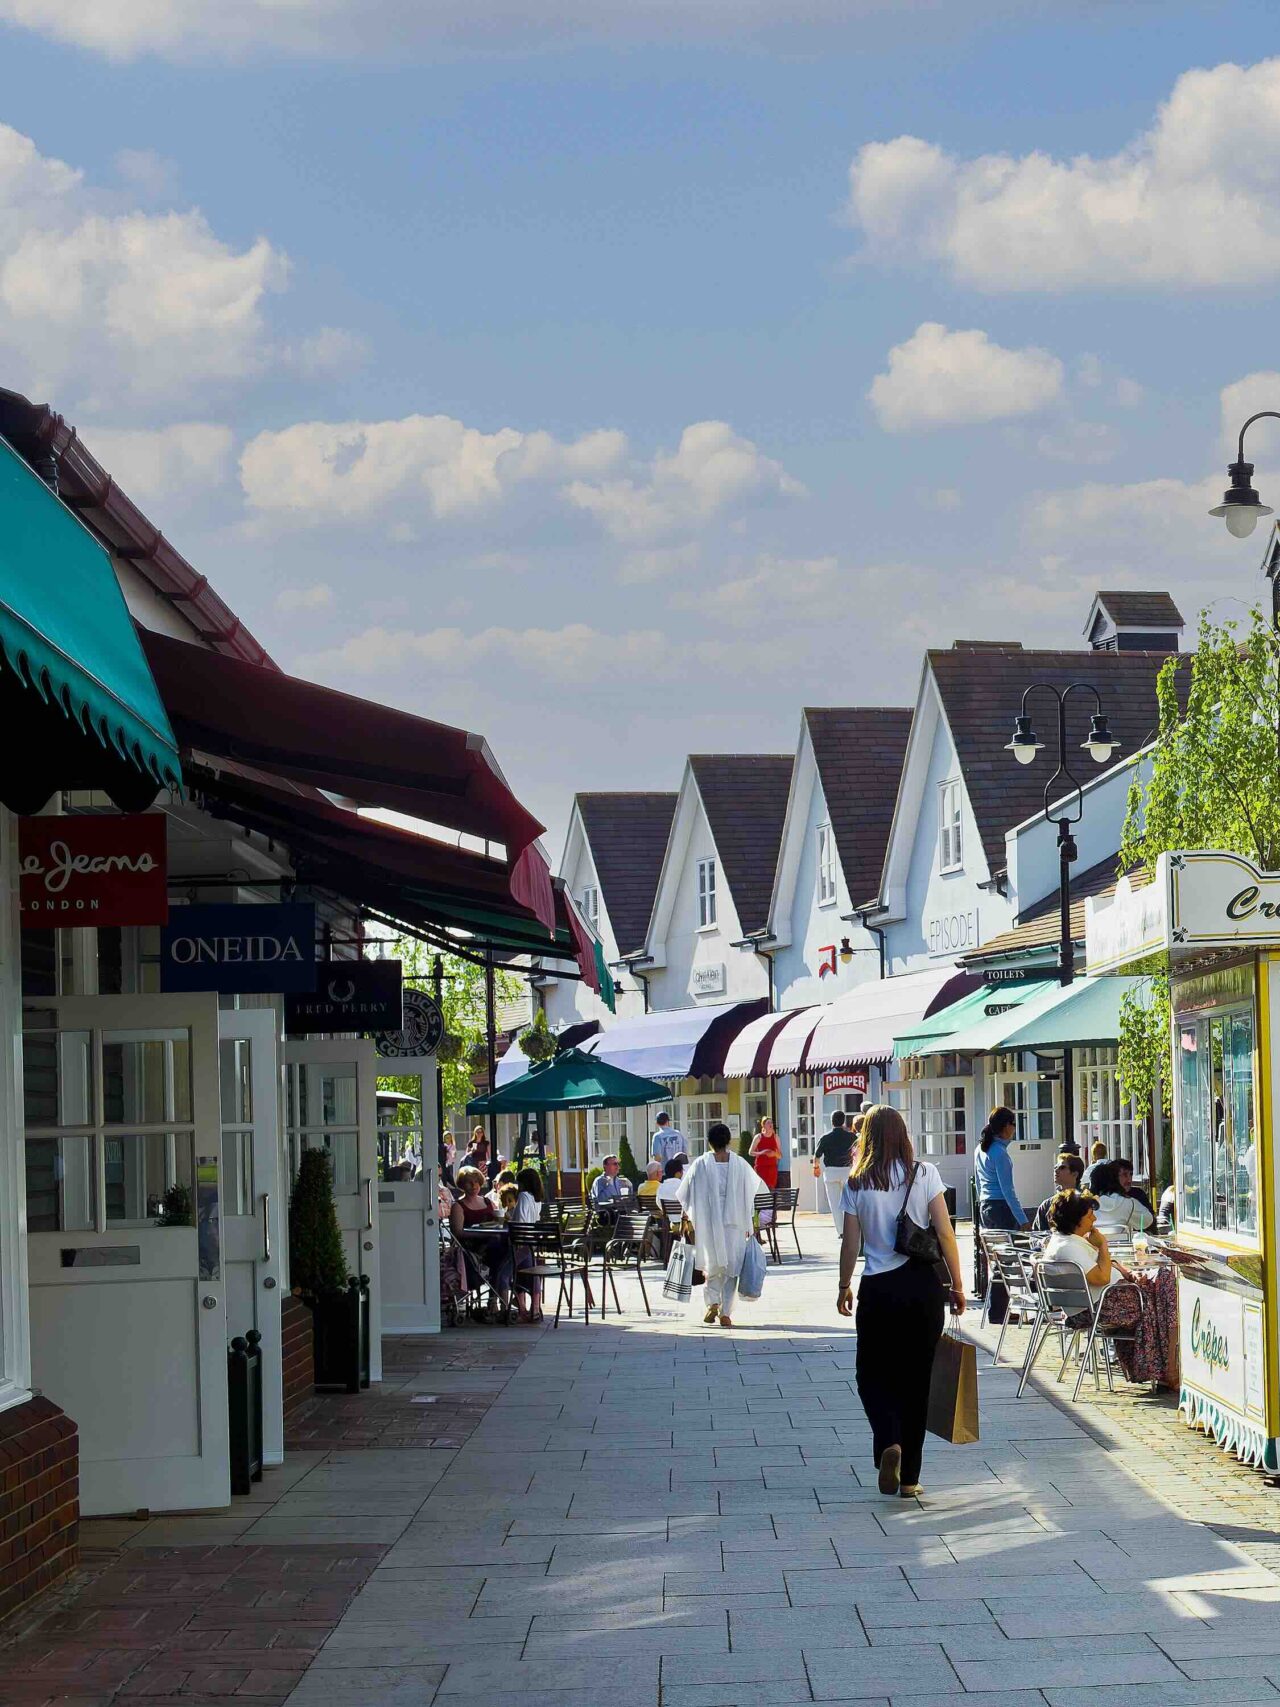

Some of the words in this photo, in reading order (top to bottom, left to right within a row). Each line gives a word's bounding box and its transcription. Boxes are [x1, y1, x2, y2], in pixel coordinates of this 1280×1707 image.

[44, 840, 159, 893] Jeans
[929, 912, 973, 953] EPISODE
[171, 936, 304, 963] ONEIDA
[987, 969, 1025, 980] TOILETS
[296, 1003, 334, 1014] FRED
[342, 1001, 388, 1014] PERRY
[379, 1040, 433, 1057] COFFEE
[825, 1075, 865, 1090] CAMPER
[1191, 1296, 1229, 1379] Crêpes
